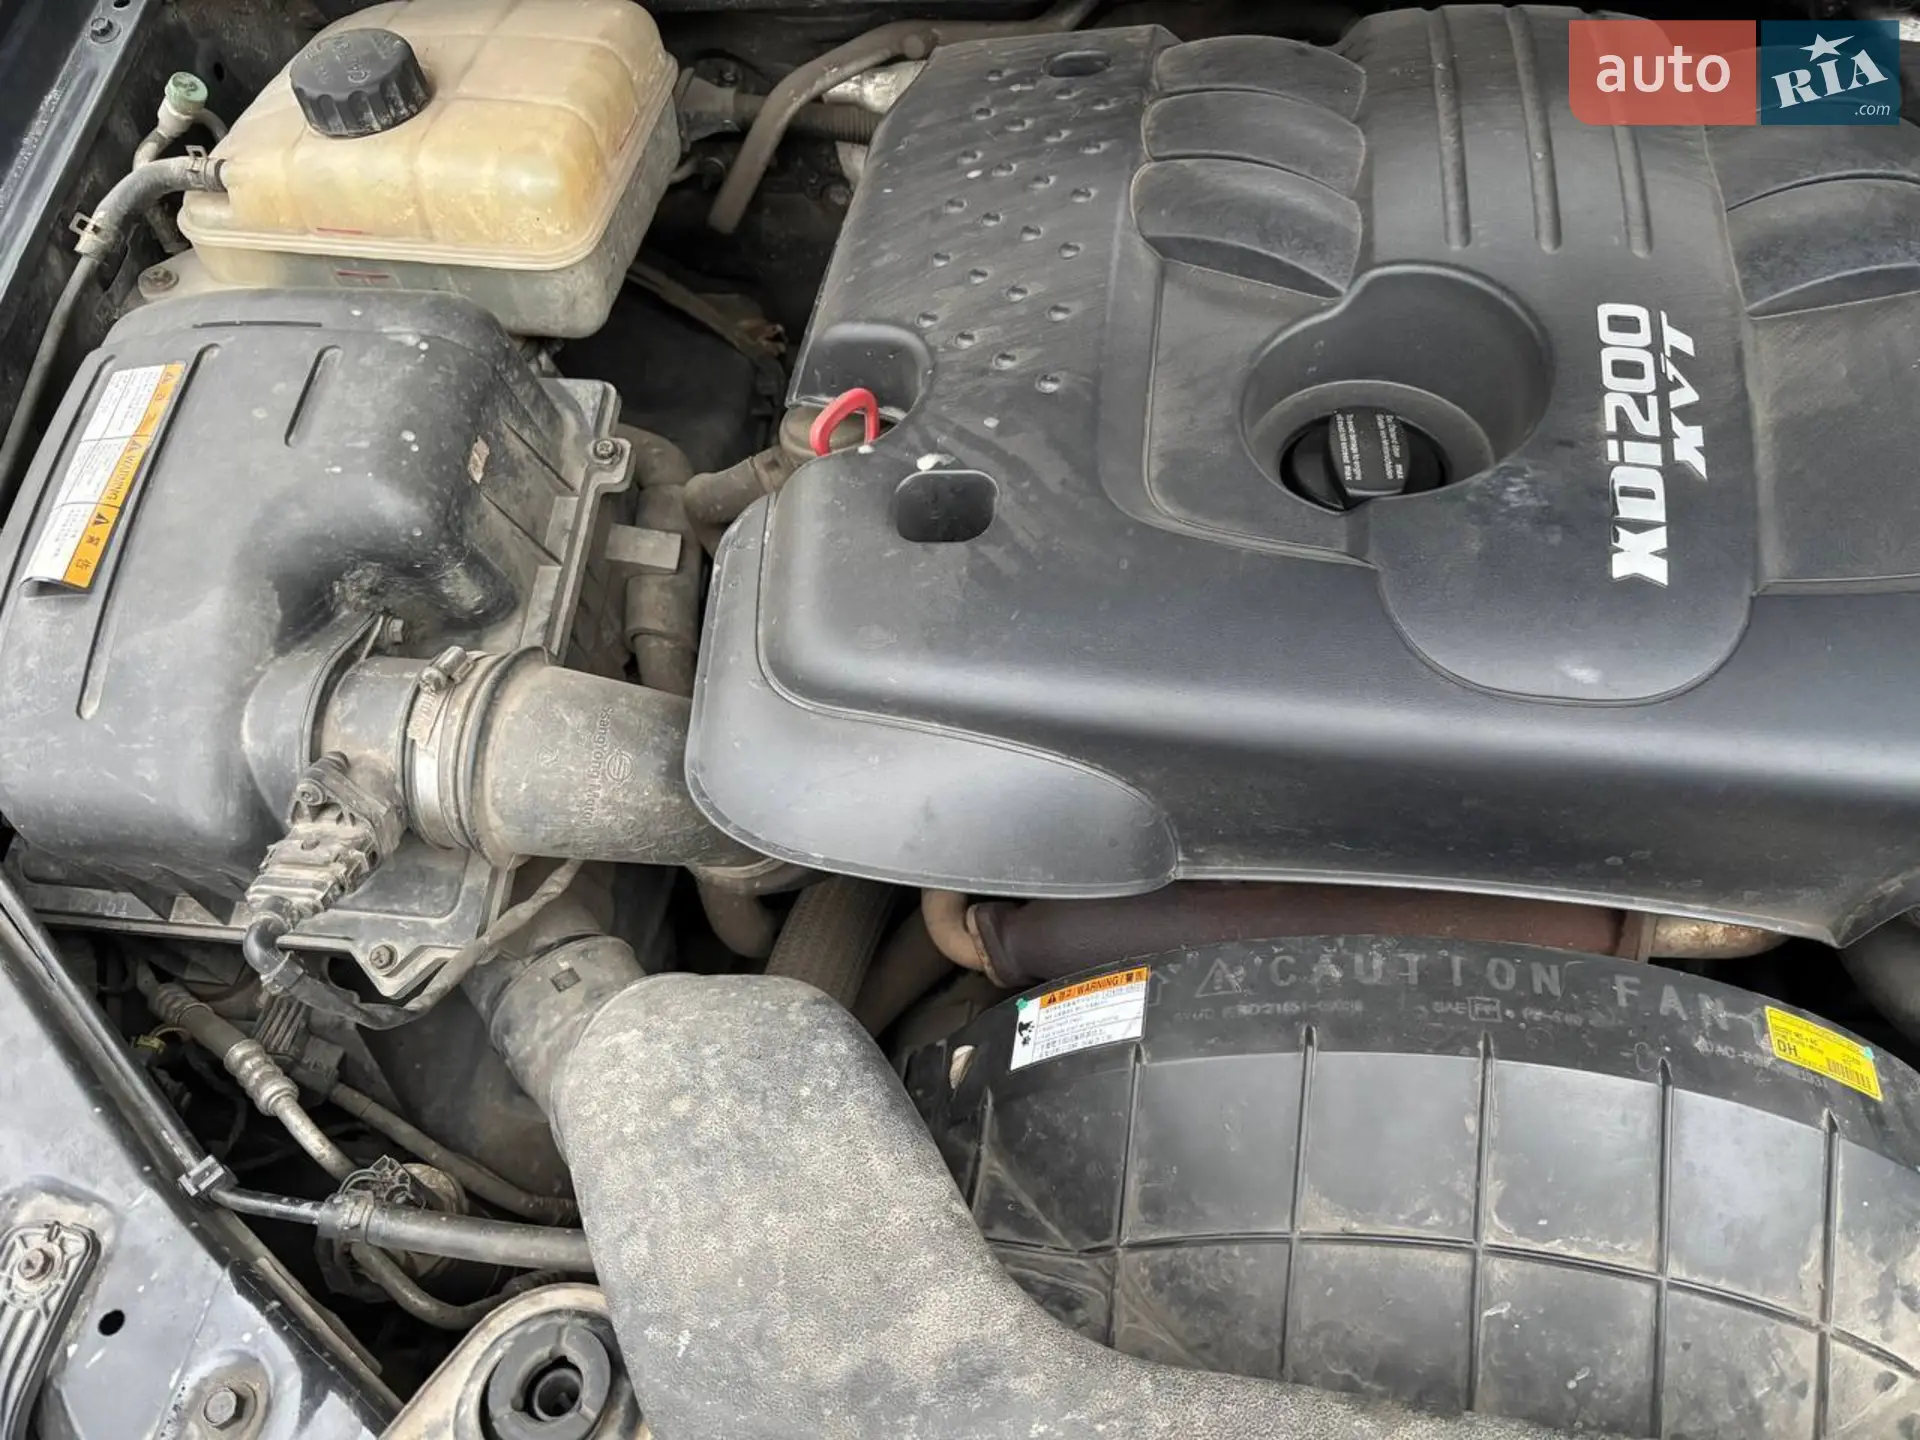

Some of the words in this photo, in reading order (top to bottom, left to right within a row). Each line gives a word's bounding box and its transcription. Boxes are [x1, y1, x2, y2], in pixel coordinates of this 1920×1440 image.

[1597, 303, 1668, 588] XDi200
[1076, 975, 1119, 996] WARNING
[1269, 951, 1561, 997] CAUTION
[1614, 975, 1729, 1031] FAN
[1777, 1039, 1798, 1057] DH
